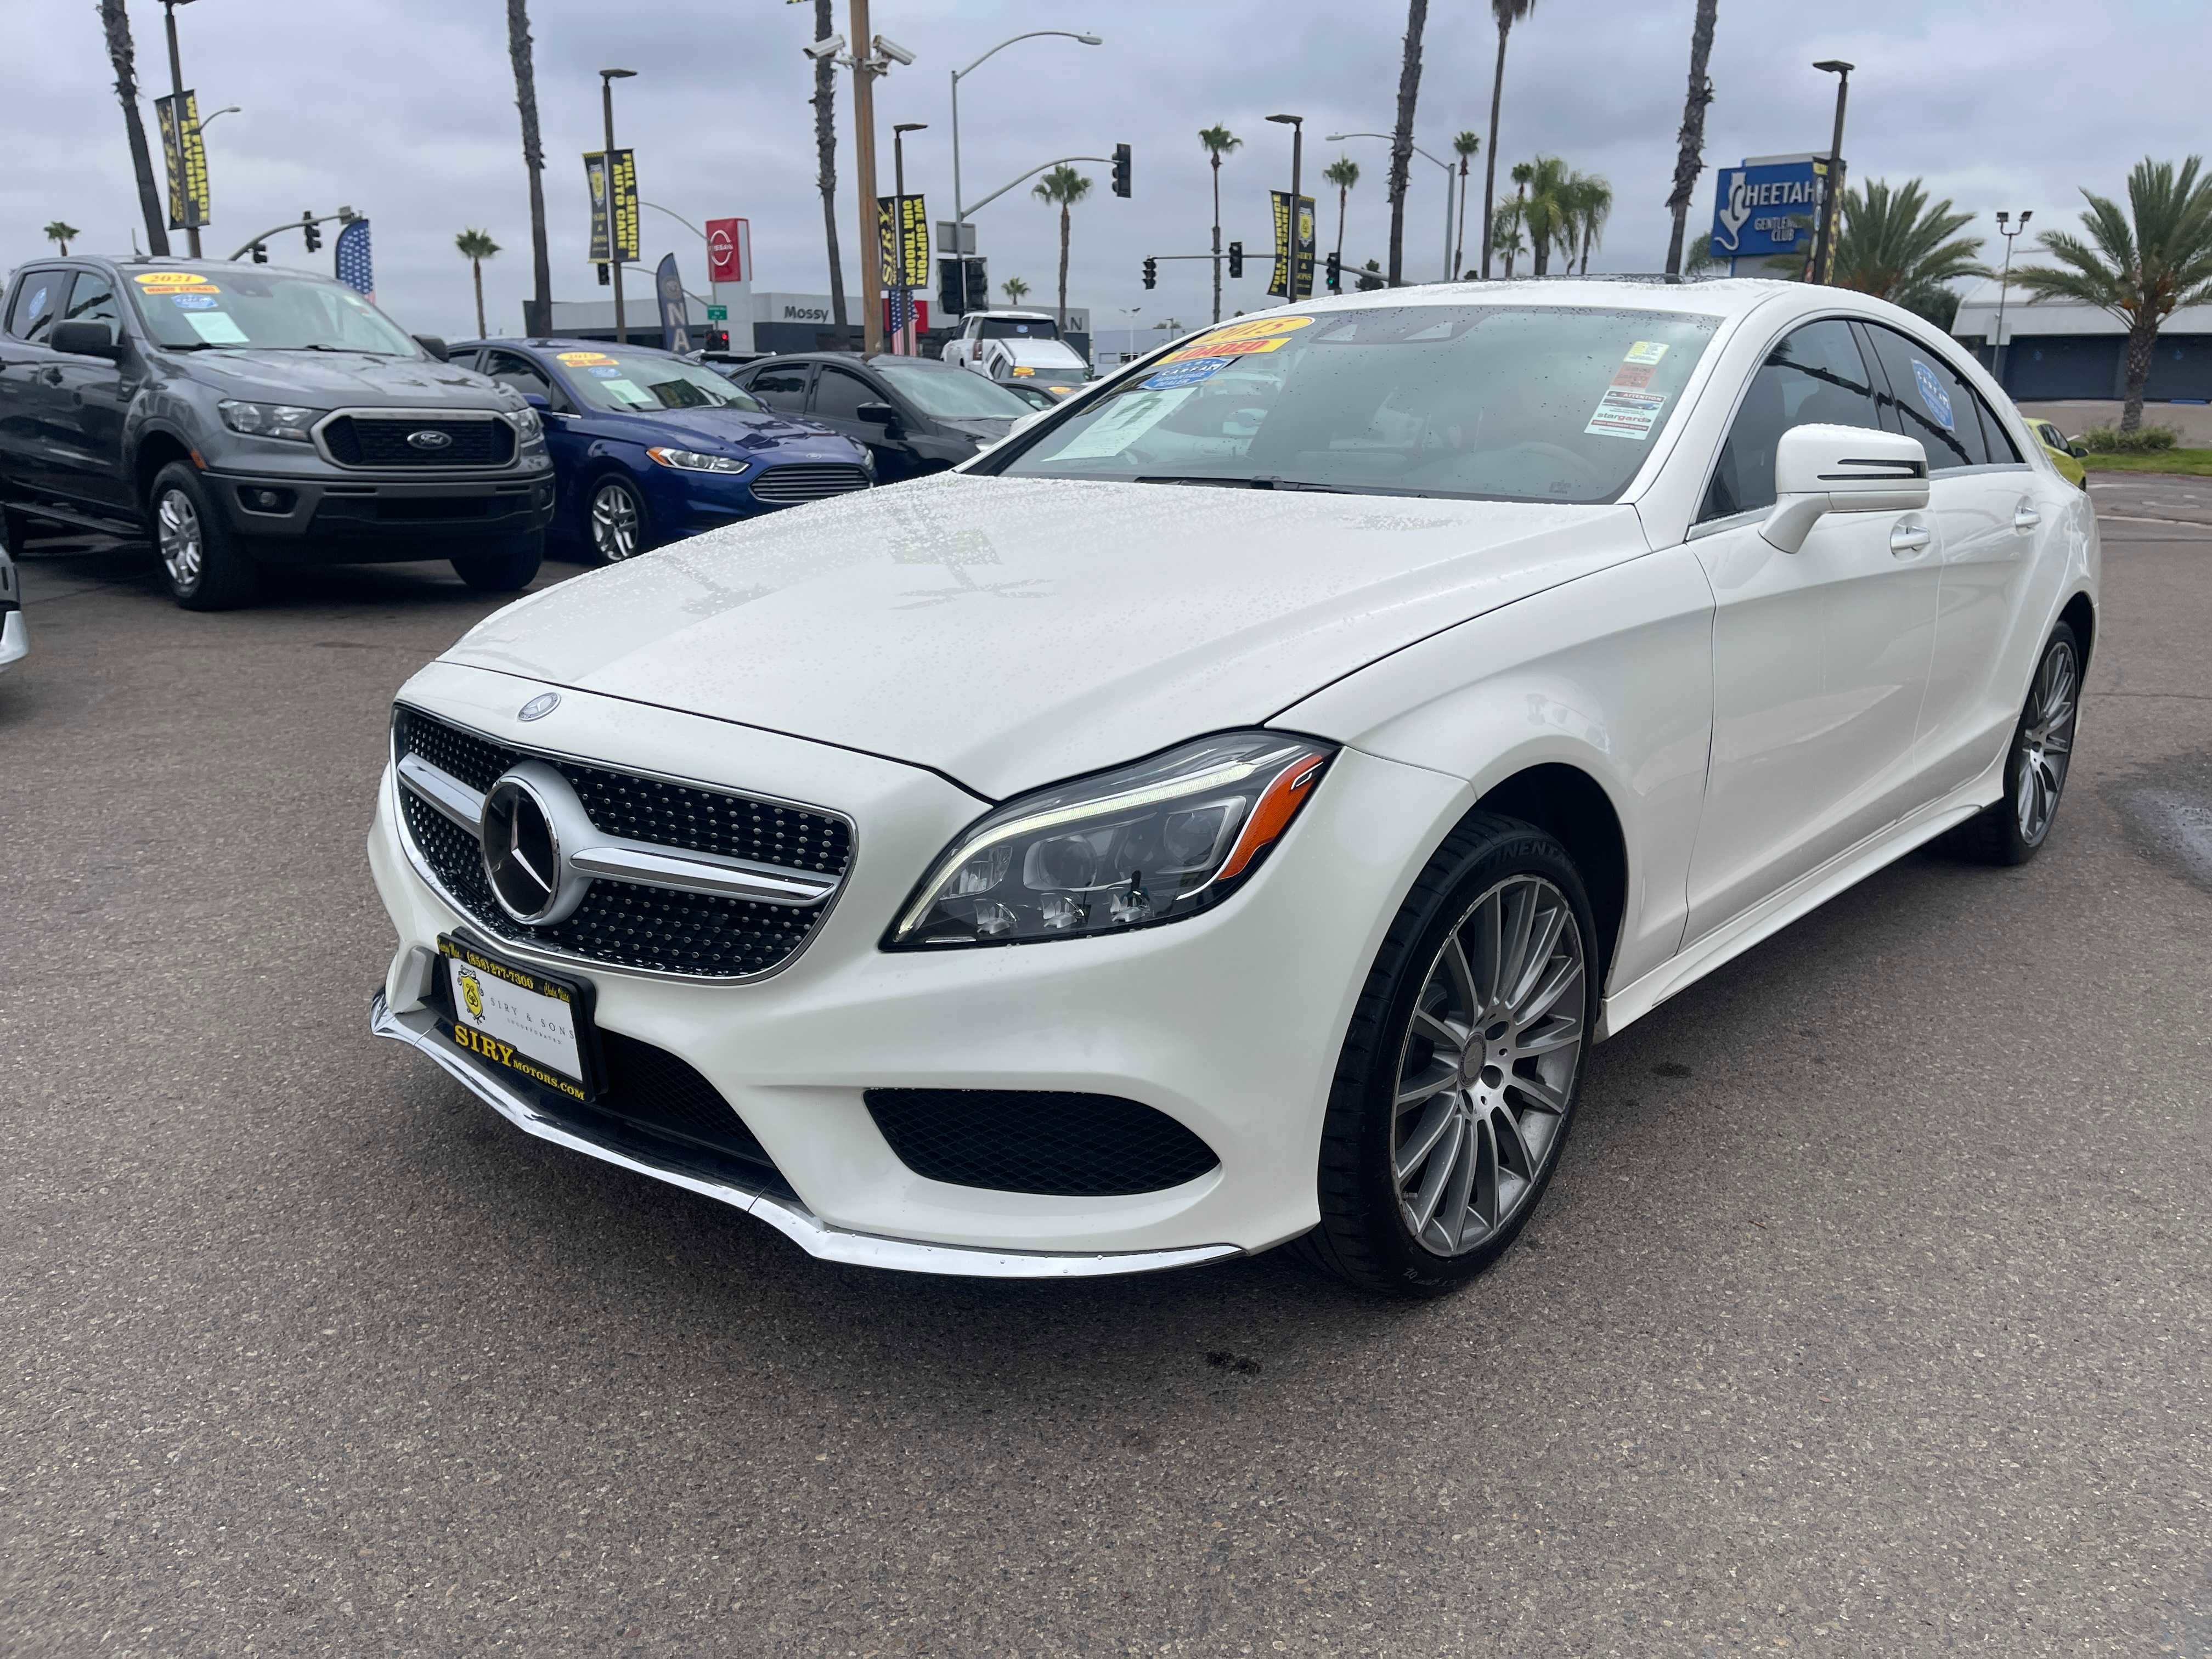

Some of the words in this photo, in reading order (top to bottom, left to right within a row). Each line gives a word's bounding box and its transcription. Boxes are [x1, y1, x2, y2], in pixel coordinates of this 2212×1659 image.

[180, 120, 198, 201] ANYONE
[192, 134, 208, 222] FINANCE
[622, 153, 635, 188] FULL
[612, 164, 625, 206] AUTO
[626, 195, 637, 258] SERVICE
[902, 200, 914, 229] OUR
[913, 198, 924, 221] WE
[616, 209, 627, 249] CARE
[1771, 228, 1795, 241] CLUB
[904, 231, 916, 285] TROOPS
[916, 223, 928, 286] SUPPORT
[784, 306, 829, 321] Mossy
[1161, 363, 1222, 376] CARFAX
[1170, 340, 1271, 362] LOADED
[420, 433, 443, 445] Ford
[490, 997, 517, 1016] SIRY
[526, 1012, 533, 1022] &
[540, 1018, 575, 1040] SONS
